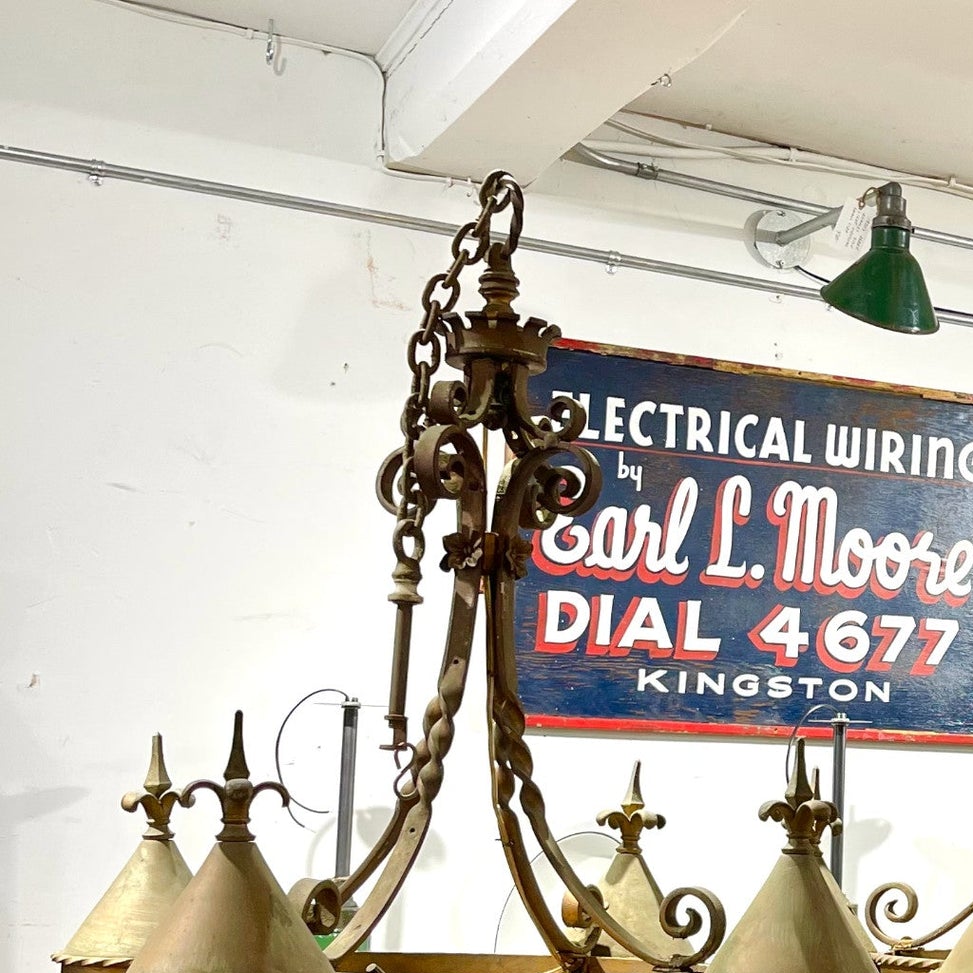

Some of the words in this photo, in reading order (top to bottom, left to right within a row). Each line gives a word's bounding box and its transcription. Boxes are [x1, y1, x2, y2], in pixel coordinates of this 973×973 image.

[617, 451, 643, 492] by
[541, 465, 699, 575] Earl
[705, 475, 765, 581] L.
[544, 589, 722, 653] DIAL
[759, 606, 960, 667] 4677
[637, 668, 891, 703] KINGSTON
